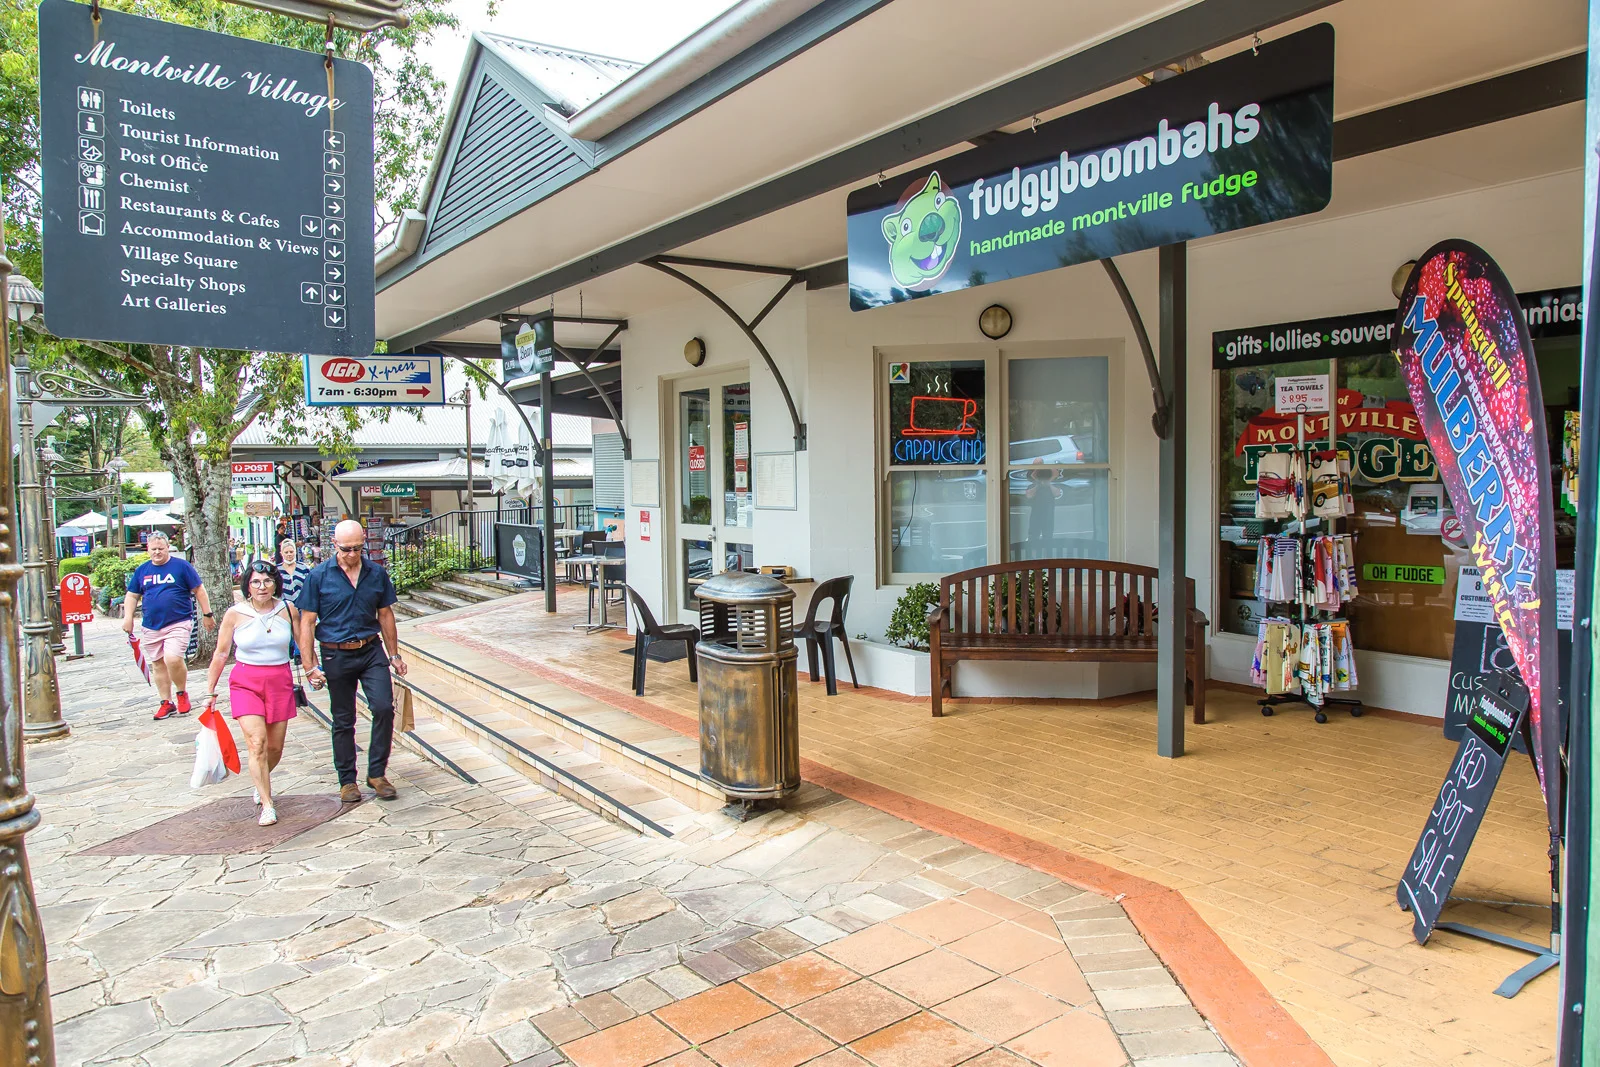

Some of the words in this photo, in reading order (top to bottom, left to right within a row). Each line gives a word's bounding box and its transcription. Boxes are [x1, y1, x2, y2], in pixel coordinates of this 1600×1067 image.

[74, 40, 236, 90] Montville
[241, 71, 346, 118] Village
[119, 98, 176, 121] Toilets
[119, 122, 180, 145] Tourist
[184, 133, 280, 162] Information
[120, 147, 156, 165] Post
[161, 153, 209, 173] Office
[968, 101, 1262, 220] fudgyboombahs
[119, 172, 191, 194] Chemist
[120, 196, 217, 221] Restaurants
[221, 209, 234, 223] &
[238, 211, 281, 229] Cafes
[969, 218, 1066, 257] handmade
[1072, 190, 1173, 232] montville
[120, 221, 254, 249] Accommodation
[258, 237, 272, 251] &
[275, 238, 319, 256] Views
[120, 244, 179, 266] Village
[183, 252, 239, 270] Square
[120, 269, 195, 292] Specialty
[199, 277, 246, 296] Shops
[121, 293, 151, 309] Art
[155, 296, 227, 315] Galleries
[1442, 262, 1511, 391] Springdell
[1226, 334, 1263, 361] gifts
[1270, 328, 1322, 353] lollies
[326, 362, 360, 378] IGA
[368, 361, 416, 381] X-press
[318, 387, 345, 396] 7am
[353, 387, 397, 398] 6:30pm
[1280, 385, 1294, 393] TEA
[1296, 384, 1324, 392] TOWELS
[1337, 395, 1350, 406] of
[1256, 411, 1419, 443] MONTVILLE
[1453, 343, 1468, 370] NO
[1464, 368, 1525, 510] PRESERVATIVES
[894, 438, 983, 462] CAPPUCCINO
[1403, 295, 1536, 595] MULBERRY
[244, 464, 269, 472] POST
[689, 458, 706, 470] CLOSED
[1243, 436, 1438, 486] FDGE
[232, 475, 266, 483] rmacy
[363, 486, 381, 494] CHE
[383, 483, 405, 494] Doctor
[143, 573, 176, 586] FILA
[1372, 566, 1388, 580] OH
[1394, 567, 1435, 583] FUDGE
[1462, 567, 1481, 576] MAX
[1474, 580, 1482, 591] 8
[66, 613, 92, 622] POST
[1451, 671, 1488, 691] CUS
[1453, 693, 1477, 715] MA
[1455, 737, 1487, 790] RED
[1432, 779, 1474, 848] SPOT
[1413, 828, 1455, 905] SALE
